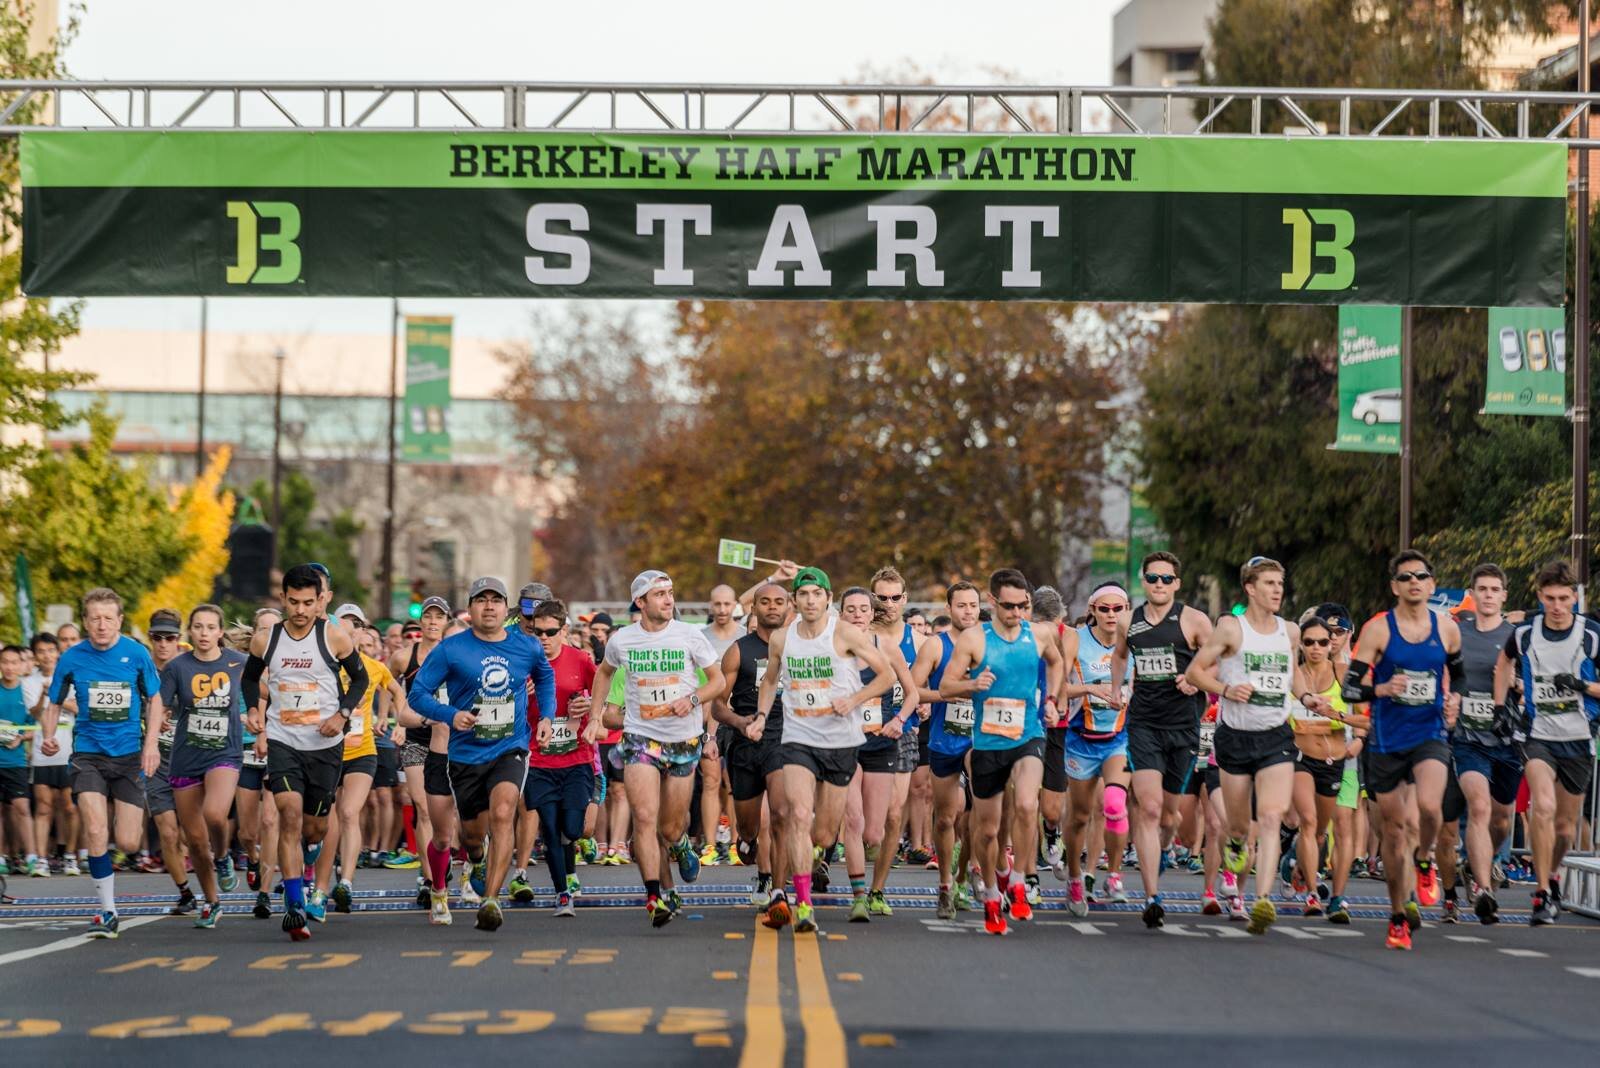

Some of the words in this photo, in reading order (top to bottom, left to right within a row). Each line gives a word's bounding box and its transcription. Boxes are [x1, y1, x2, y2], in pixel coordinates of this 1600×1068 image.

[449, 144, 700, 182] BERKELEY
[714, 146, 842, 181] HALF
[856, 147, 1137, 182] MARATHON
[226, 201, 302, 284] B
[524, 202, 1060, 288] START
[1281, 208, 1355, 290] B
[1341, 345, 1399, 366] Conditions
[627, 649, 659, 661] That's
[661, 648, 685, 660] Fine
[786, 656, 812, 668] That's
[813, 655, 831, 667] Fine
[627, 660, 658, 673] Track
[660, 660, 685, 673] Club
[1139, 657, 1173, 672] 7115
[788, 668, 813, 679] Track
[813, 667, 834, 679] Club
[191, 671, 231, 698] GO
[1258, 675, 1282, 690] 152
[96, 692, 123, 706] 239
[294, 695, 302, 708] 7
[650, 689, 666, 702] 11
[806, 693, 815, 706] 9
[490, 708, 498, 721] 1
[863, 709, 872, 722] 6
[996, 709, 1013, 724] 13
[196, 719, 221, 733] 144
[919, 919, 1365, 940] STOP
